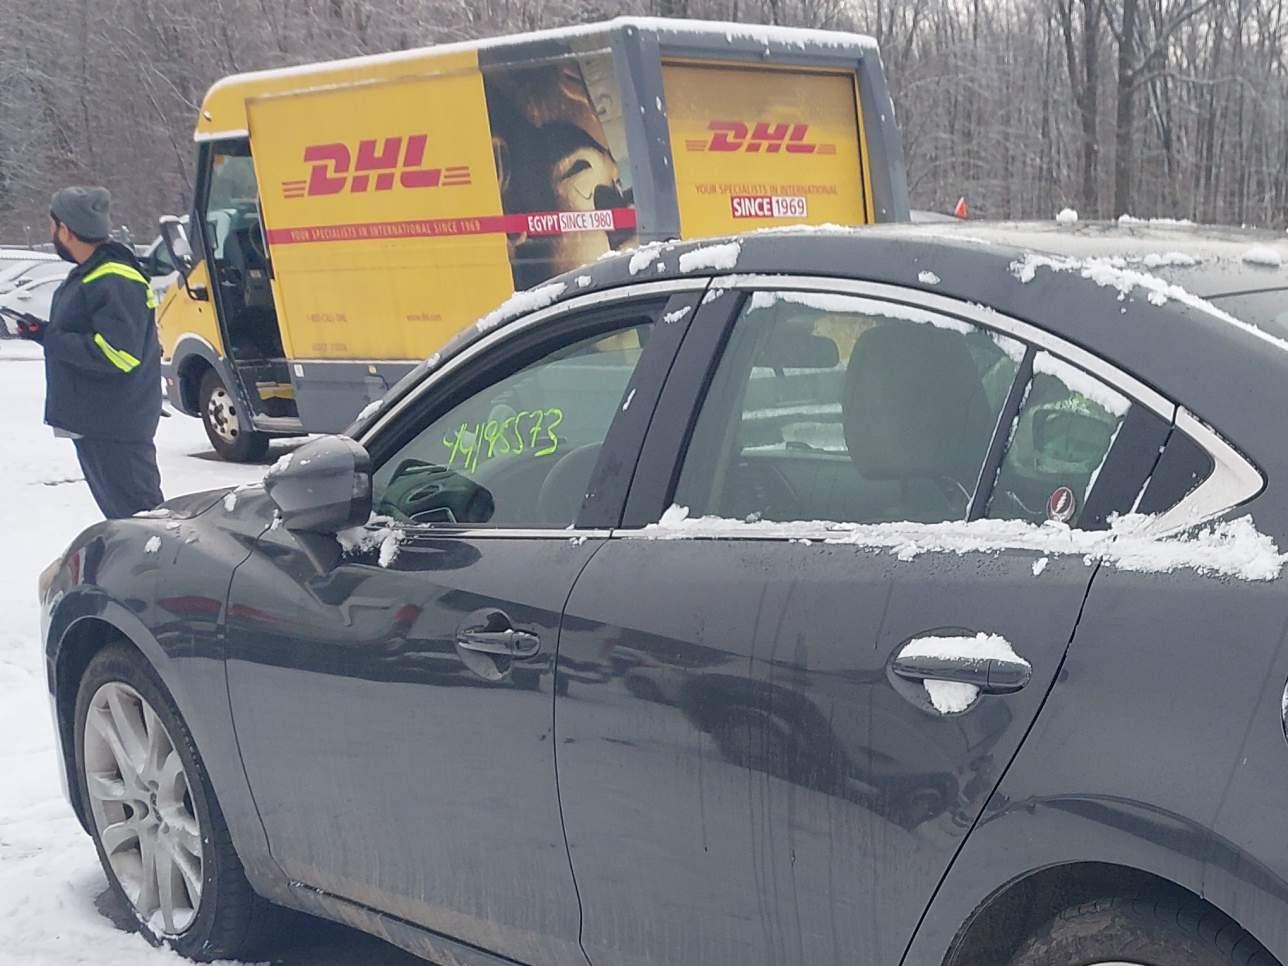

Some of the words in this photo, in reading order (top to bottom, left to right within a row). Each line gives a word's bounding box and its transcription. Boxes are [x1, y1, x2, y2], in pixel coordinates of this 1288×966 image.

[708, 121, 816, 154] DHL
[303, 134, 442, 196] DHL
[527, 214, 559, 232] EGYPT
[560, 213, 588, 230] SINCE
[589, 211, 612, 228] 1980
[733, 197, 771, 217] SINCE
[775, 198, 805, 216] 1969
[442, 407, 563, 474] 44195573
